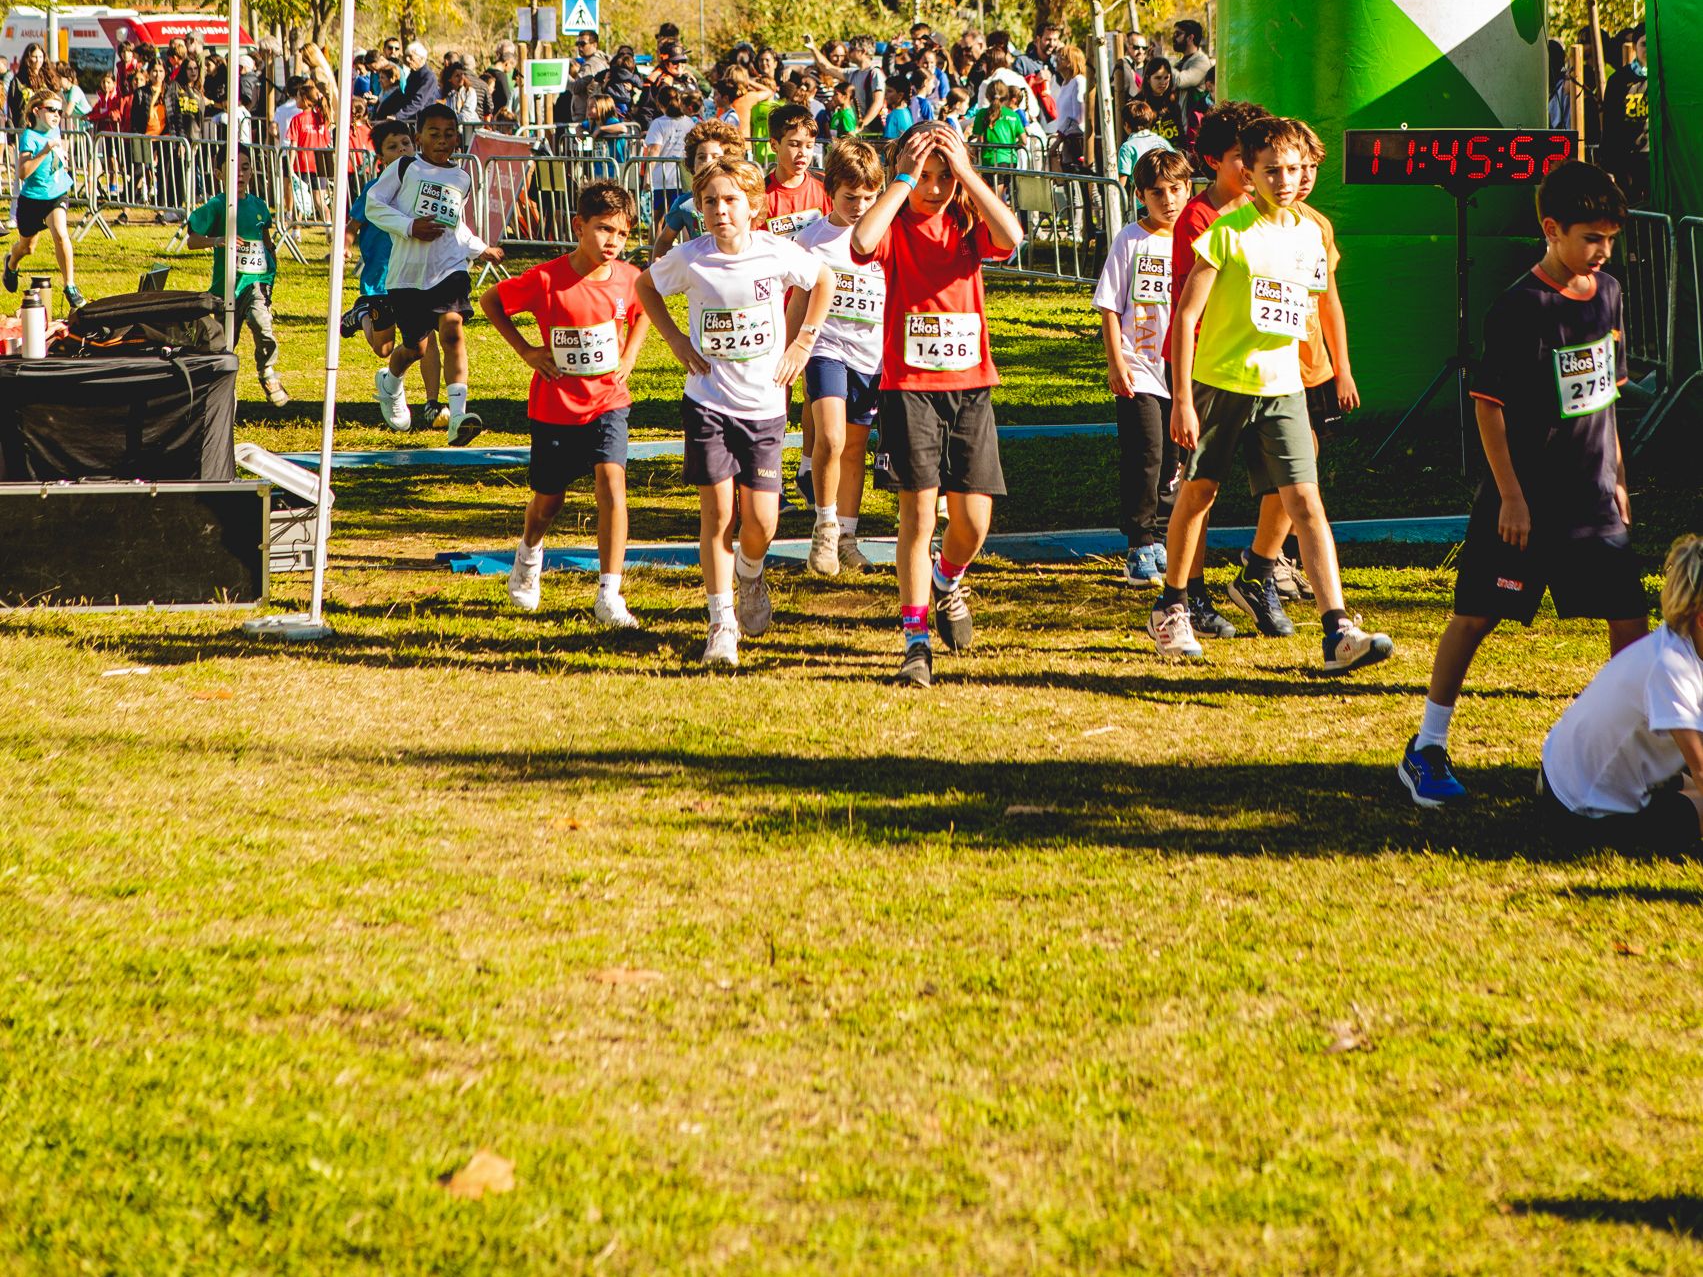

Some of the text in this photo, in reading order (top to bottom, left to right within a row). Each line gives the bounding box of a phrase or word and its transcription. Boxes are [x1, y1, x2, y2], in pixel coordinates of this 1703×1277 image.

[1371, 135, 1571, 180] 11:45:52
[421, 199, 455, 218] 2695
[1140, 264, 1164, 273] CROS
[1256, 285, 1281, 299] CROS
[832, 295, 875, 312] 3251
[1260, 306, 1299, 326] 2216
[706, 320, 732, 329] CROS
[911, 323, 939, 334] CROS
[555, 336, 580, 345] CROS
[710, 333, 764, 351] 3249
[566, 350, 604, 365] 869
[916, 343, 967, 357] 1436
[1561, 357, 1594, 373] CROS
